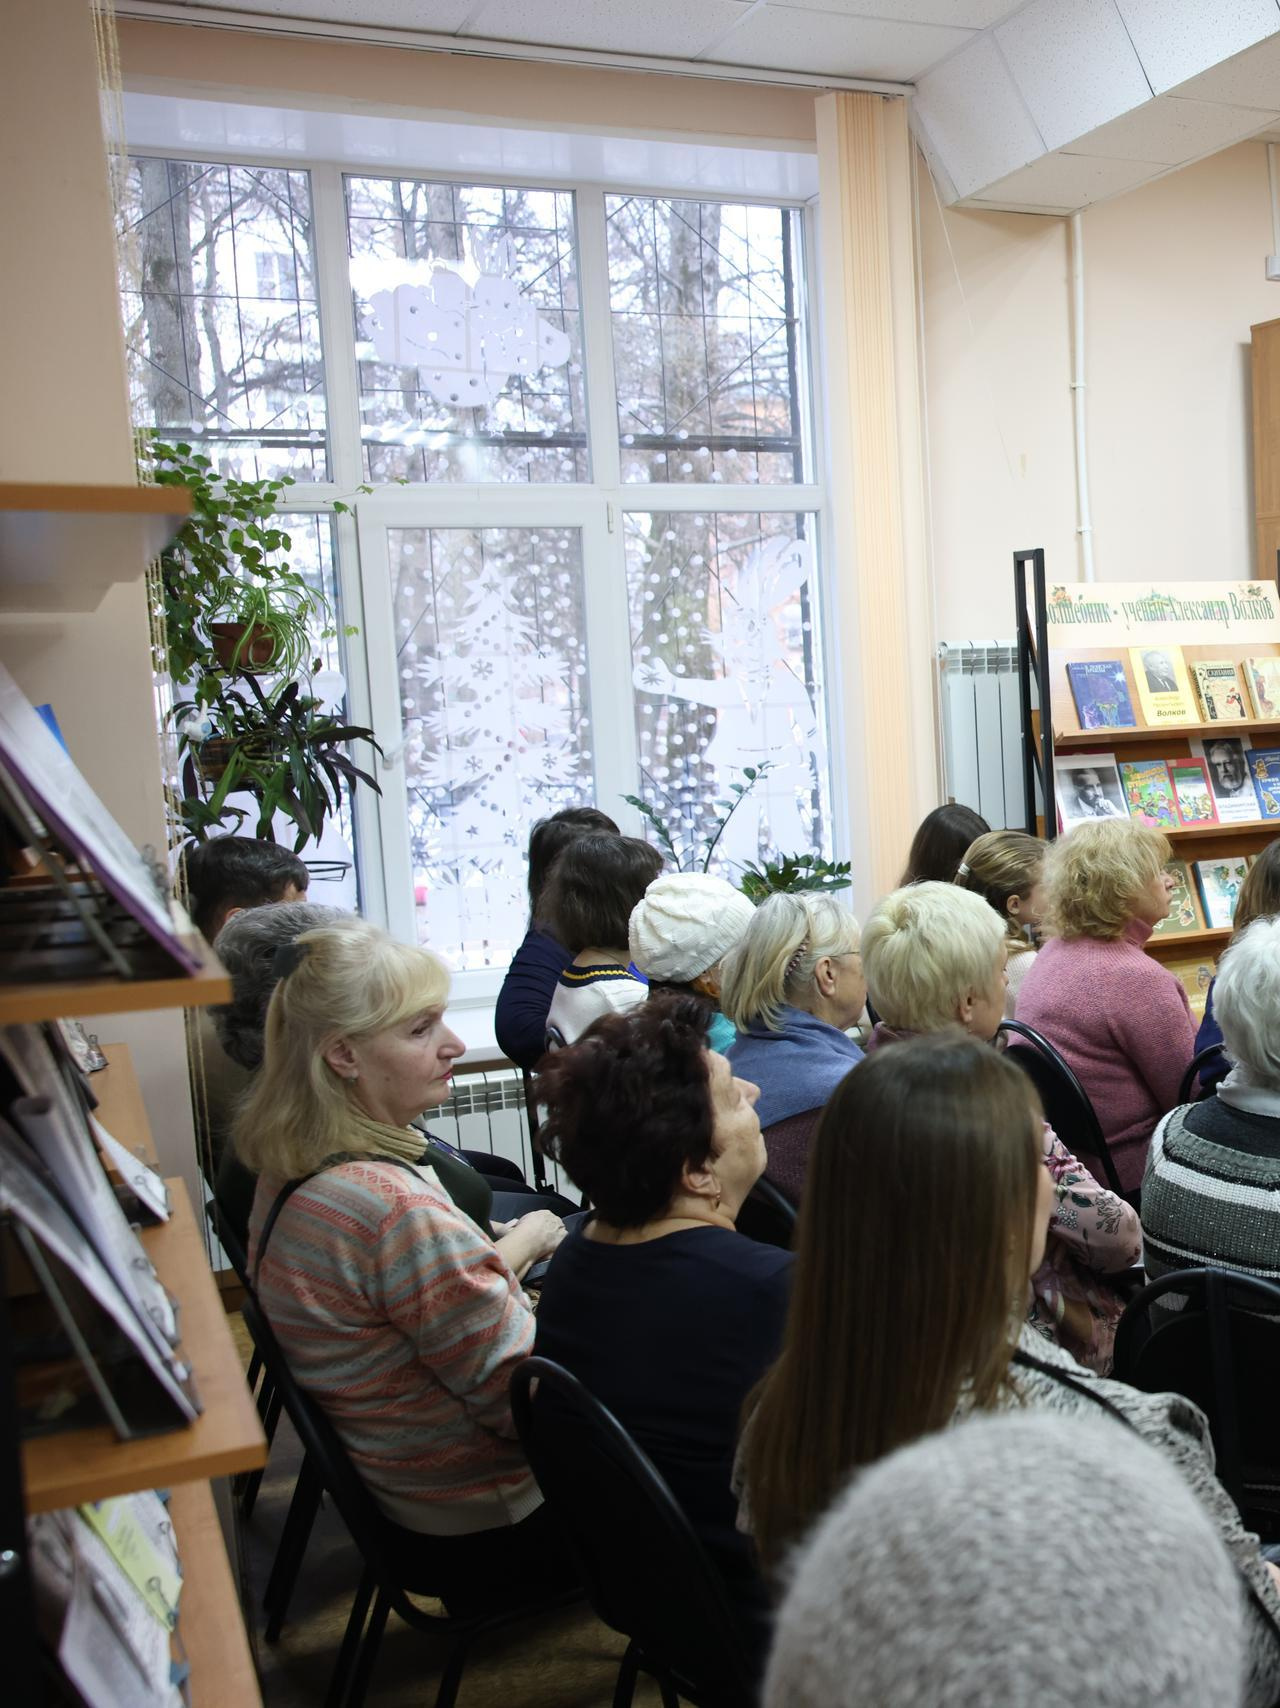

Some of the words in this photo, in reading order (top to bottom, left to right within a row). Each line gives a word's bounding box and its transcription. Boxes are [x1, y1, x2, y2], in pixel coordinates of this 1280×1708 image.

[1047, 601, 1112, 624] олшебник
[1168, 594, 1231, 629] Александр
[1228, 592, 1275, 621] Волков
[1157, 709, 1186, 717] Волков
